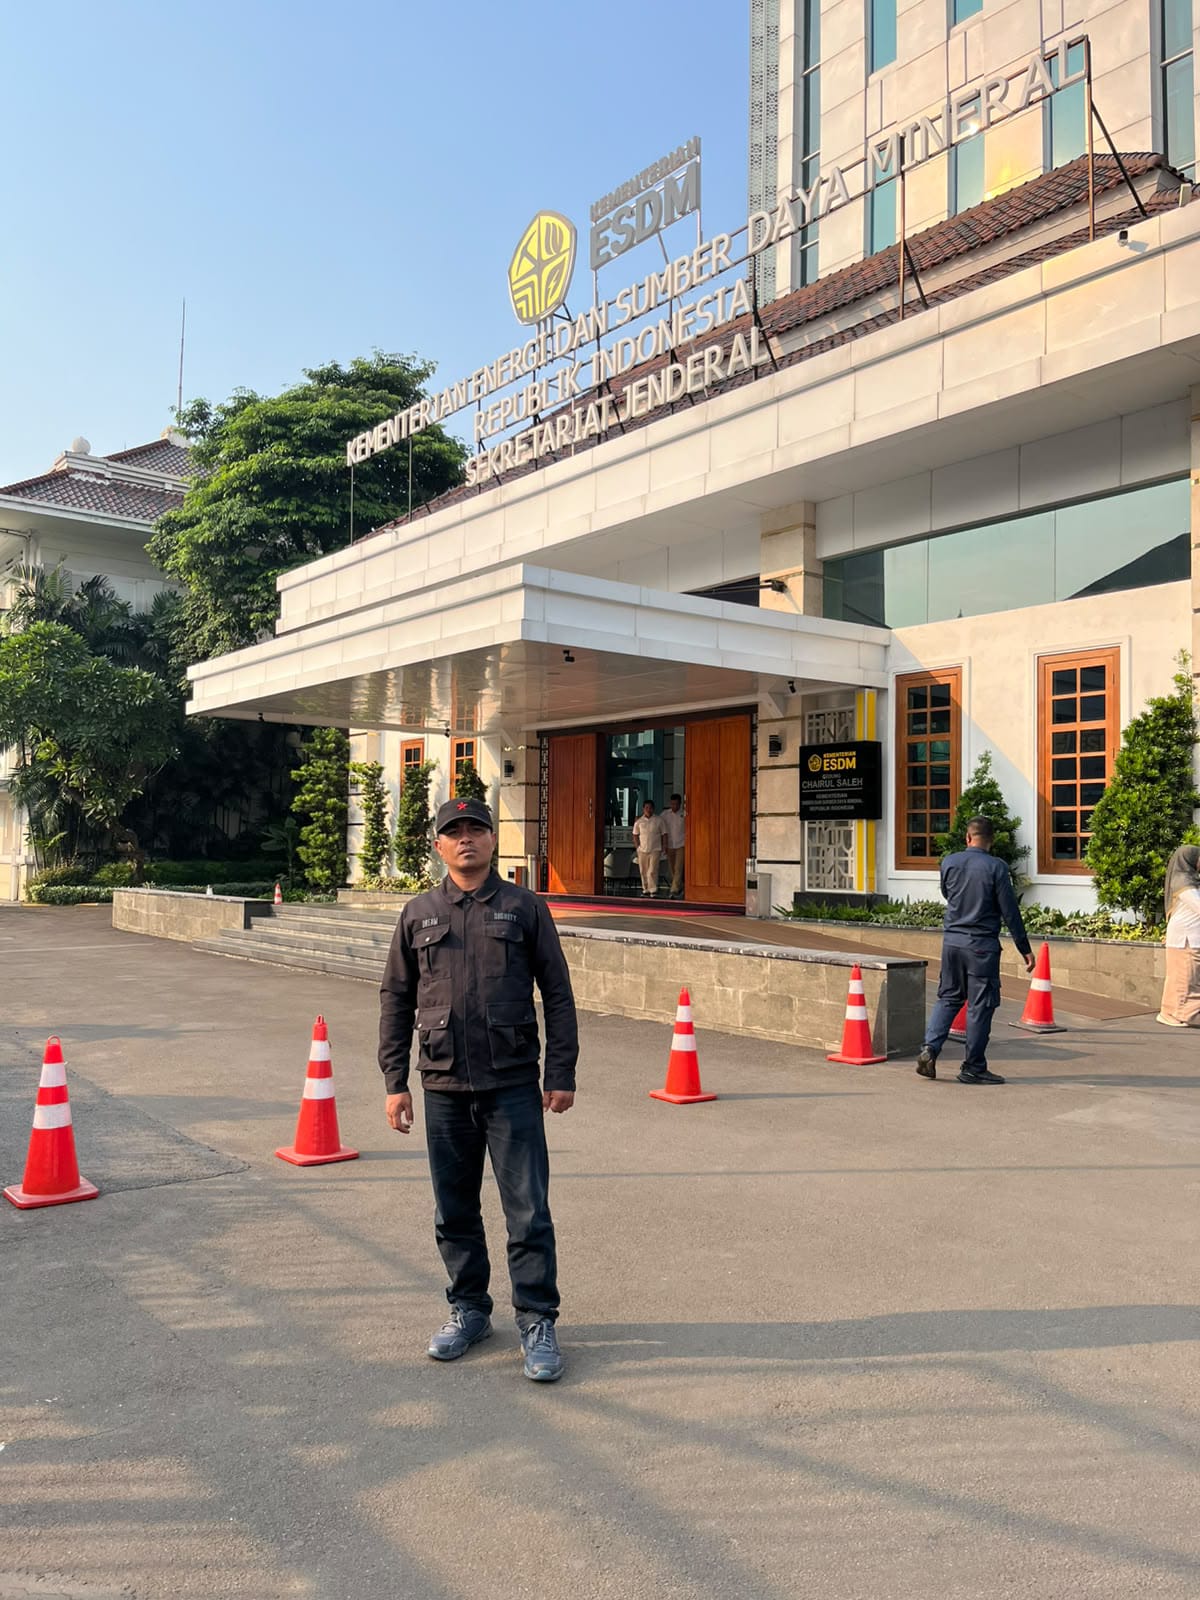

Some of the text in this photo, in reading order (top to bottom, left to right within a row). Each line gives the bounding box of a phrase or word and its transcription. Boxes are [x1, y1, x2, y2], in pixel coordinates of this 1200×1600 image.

[347, 38, 1089, 467] KEMENTERIAN ENERGI DAN SUMBER DAYA MINERAL
[590, 161, 701, 271] ESDM
[465, 326, 771, 488] SEKRETARIAT JENDERAL
[474, 278, 751, 442] REPUBLIK INDONESIA
[802, 778, 863, 789] CHAIRUL SALEH
[823, 757, 856, 771] ESDM
